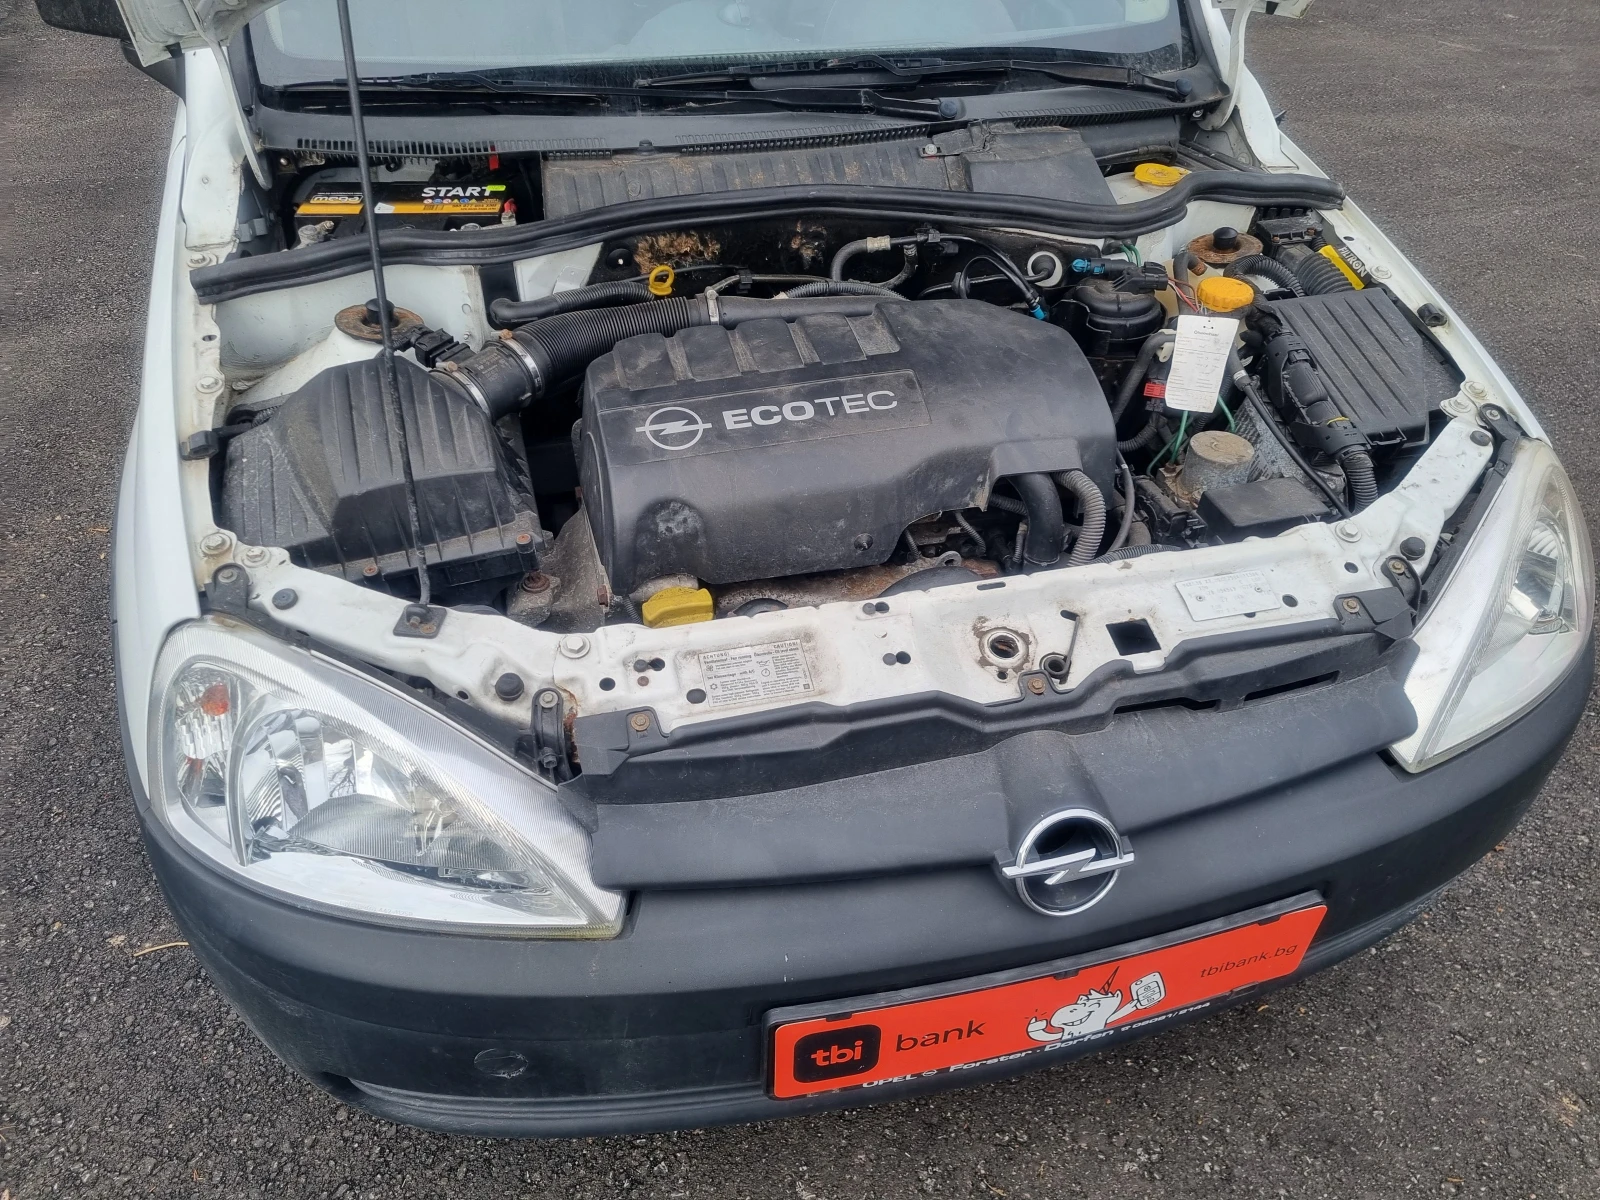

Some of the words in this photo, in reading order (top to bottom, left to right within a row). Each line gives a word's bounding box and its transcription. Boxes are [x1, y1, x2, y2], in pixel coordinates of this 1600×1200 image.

[421, 185, 494, 197] START
[1338, 245, 1368, 278] FILTRON
[722, 390, 898, 430] ECOTEC
[1200, 944, 1298, 979] tbibank.bg
[811, 1040, 863, 1067] tbi
[896, 1020, 986, 1052] bank
[862, 1073, 917, 1088] OPEL
[1044, 1029, 1114, 1052] Dorfen
